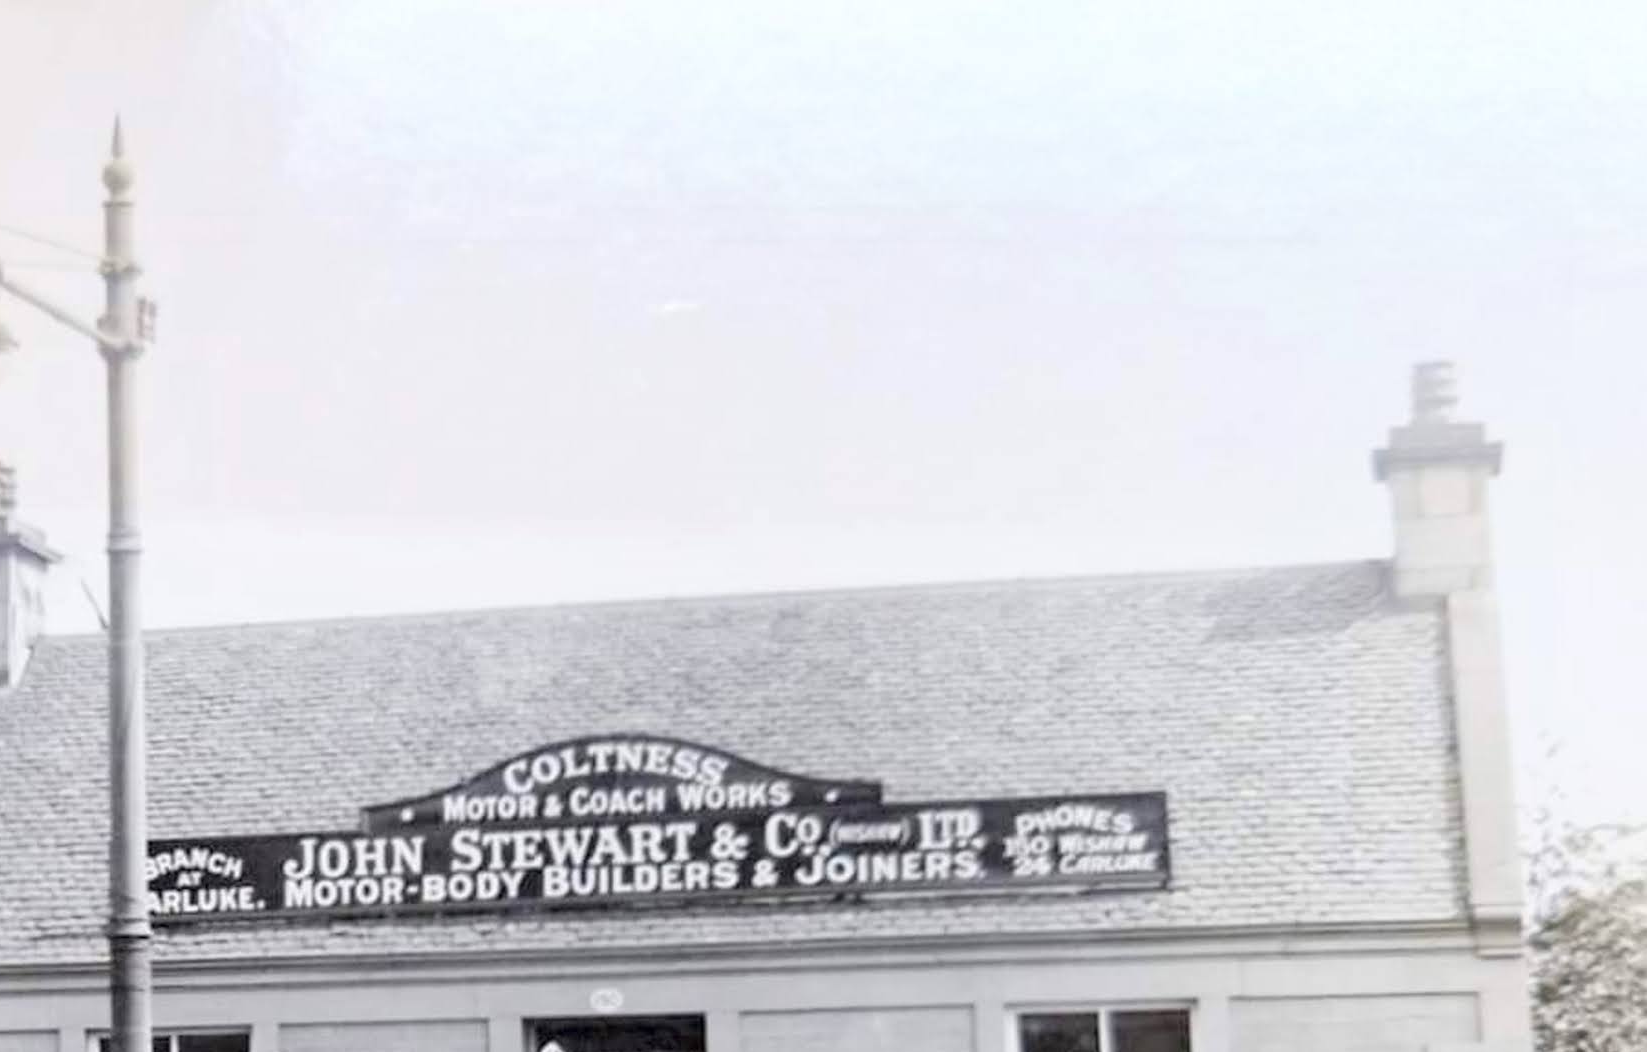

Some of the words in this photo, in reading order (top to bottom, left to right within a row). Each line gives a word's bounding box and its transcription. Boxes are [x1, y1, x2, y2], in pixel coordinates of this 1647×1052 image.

[503, 741, 731, 794] COLTNESS
[443, 794, 537, 823] MOTOR
[543, 794, 564, 818] &
[569, 786, 666, 815] COACH
[676, 781, 793, 811] WORKS
[1015, 802, 1135, 837] PHONES
[146, 847, 243, 881] BRANCH
[283, 836, 427, 878] JOHN
[451, 821, 697, 873] STEWART
[710, 823, 750, 861] &
[176, 871, 204, 888] AT
[285, 871, 524, 909] MOTOR-BODY
[543, 859, 740, 898] BUILDERS
[751, 858, 779, 888] &
[145, 887, 266, 914] ARLUKE.
